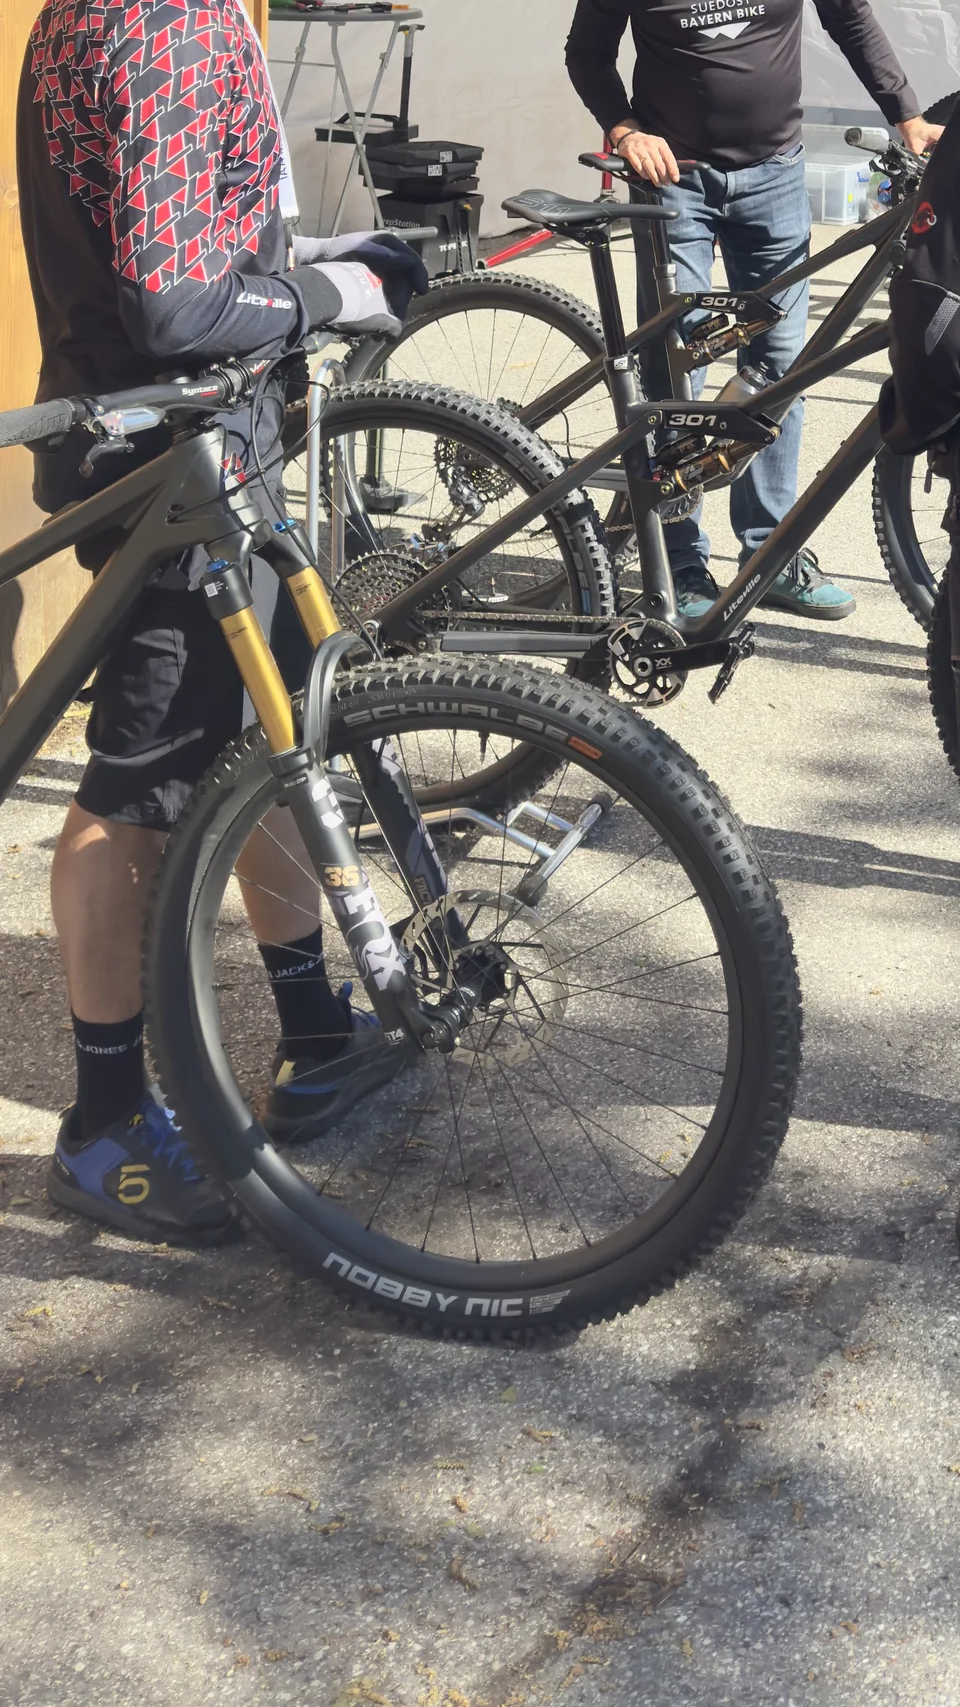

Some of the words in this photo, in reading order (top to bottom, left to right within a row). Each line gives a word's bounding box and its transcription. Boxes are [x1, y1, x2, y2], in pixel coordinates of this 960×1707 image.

[680, 10, 733, 29] BAYERN
[736, 4, 766, 18] BIKE
[382, 218, 421, 229] repStation
[439, 240, 468, 252] TOPEK
[701, 296, 739, 307] 301
[182, 385, 218, 396] Syntace
[669, 413, 717, 427] 301
[723, 574, 761, 622] Liteville
[343, 701, 569, 743] SCHWALBE
[324, 865, 360, 887] 36
[343, 886, 407, 991] FOX
[322, 1252, 459, 1312] NOBBY
[464, 1297, 524, 1317] NIC
